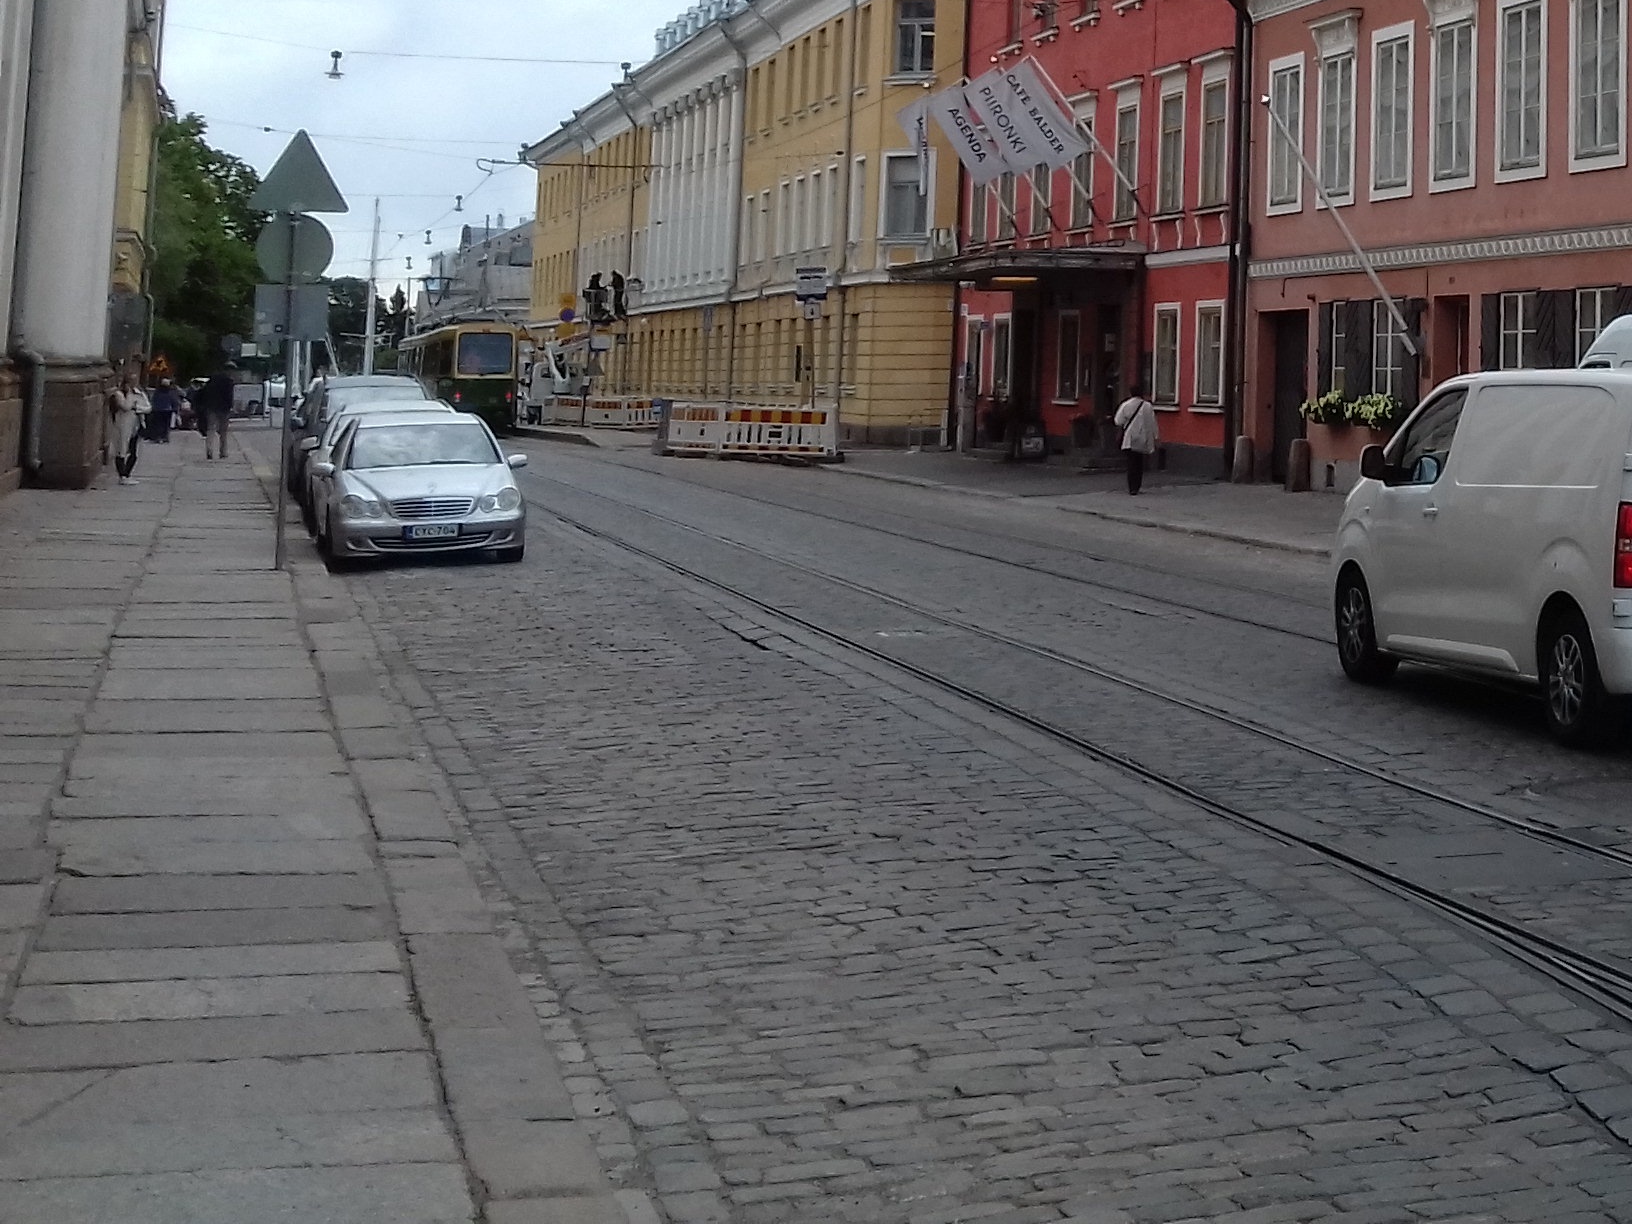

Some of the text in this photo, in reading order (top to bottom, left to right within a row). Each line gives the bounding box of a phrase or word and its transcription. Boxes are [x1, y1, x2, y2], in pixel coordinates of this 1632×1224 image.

[947, 107, 988, 163] AGENDA
[978, 85, 1028, 154] PIIRONKI
[1028, 107, 1065, 155] BALDER
